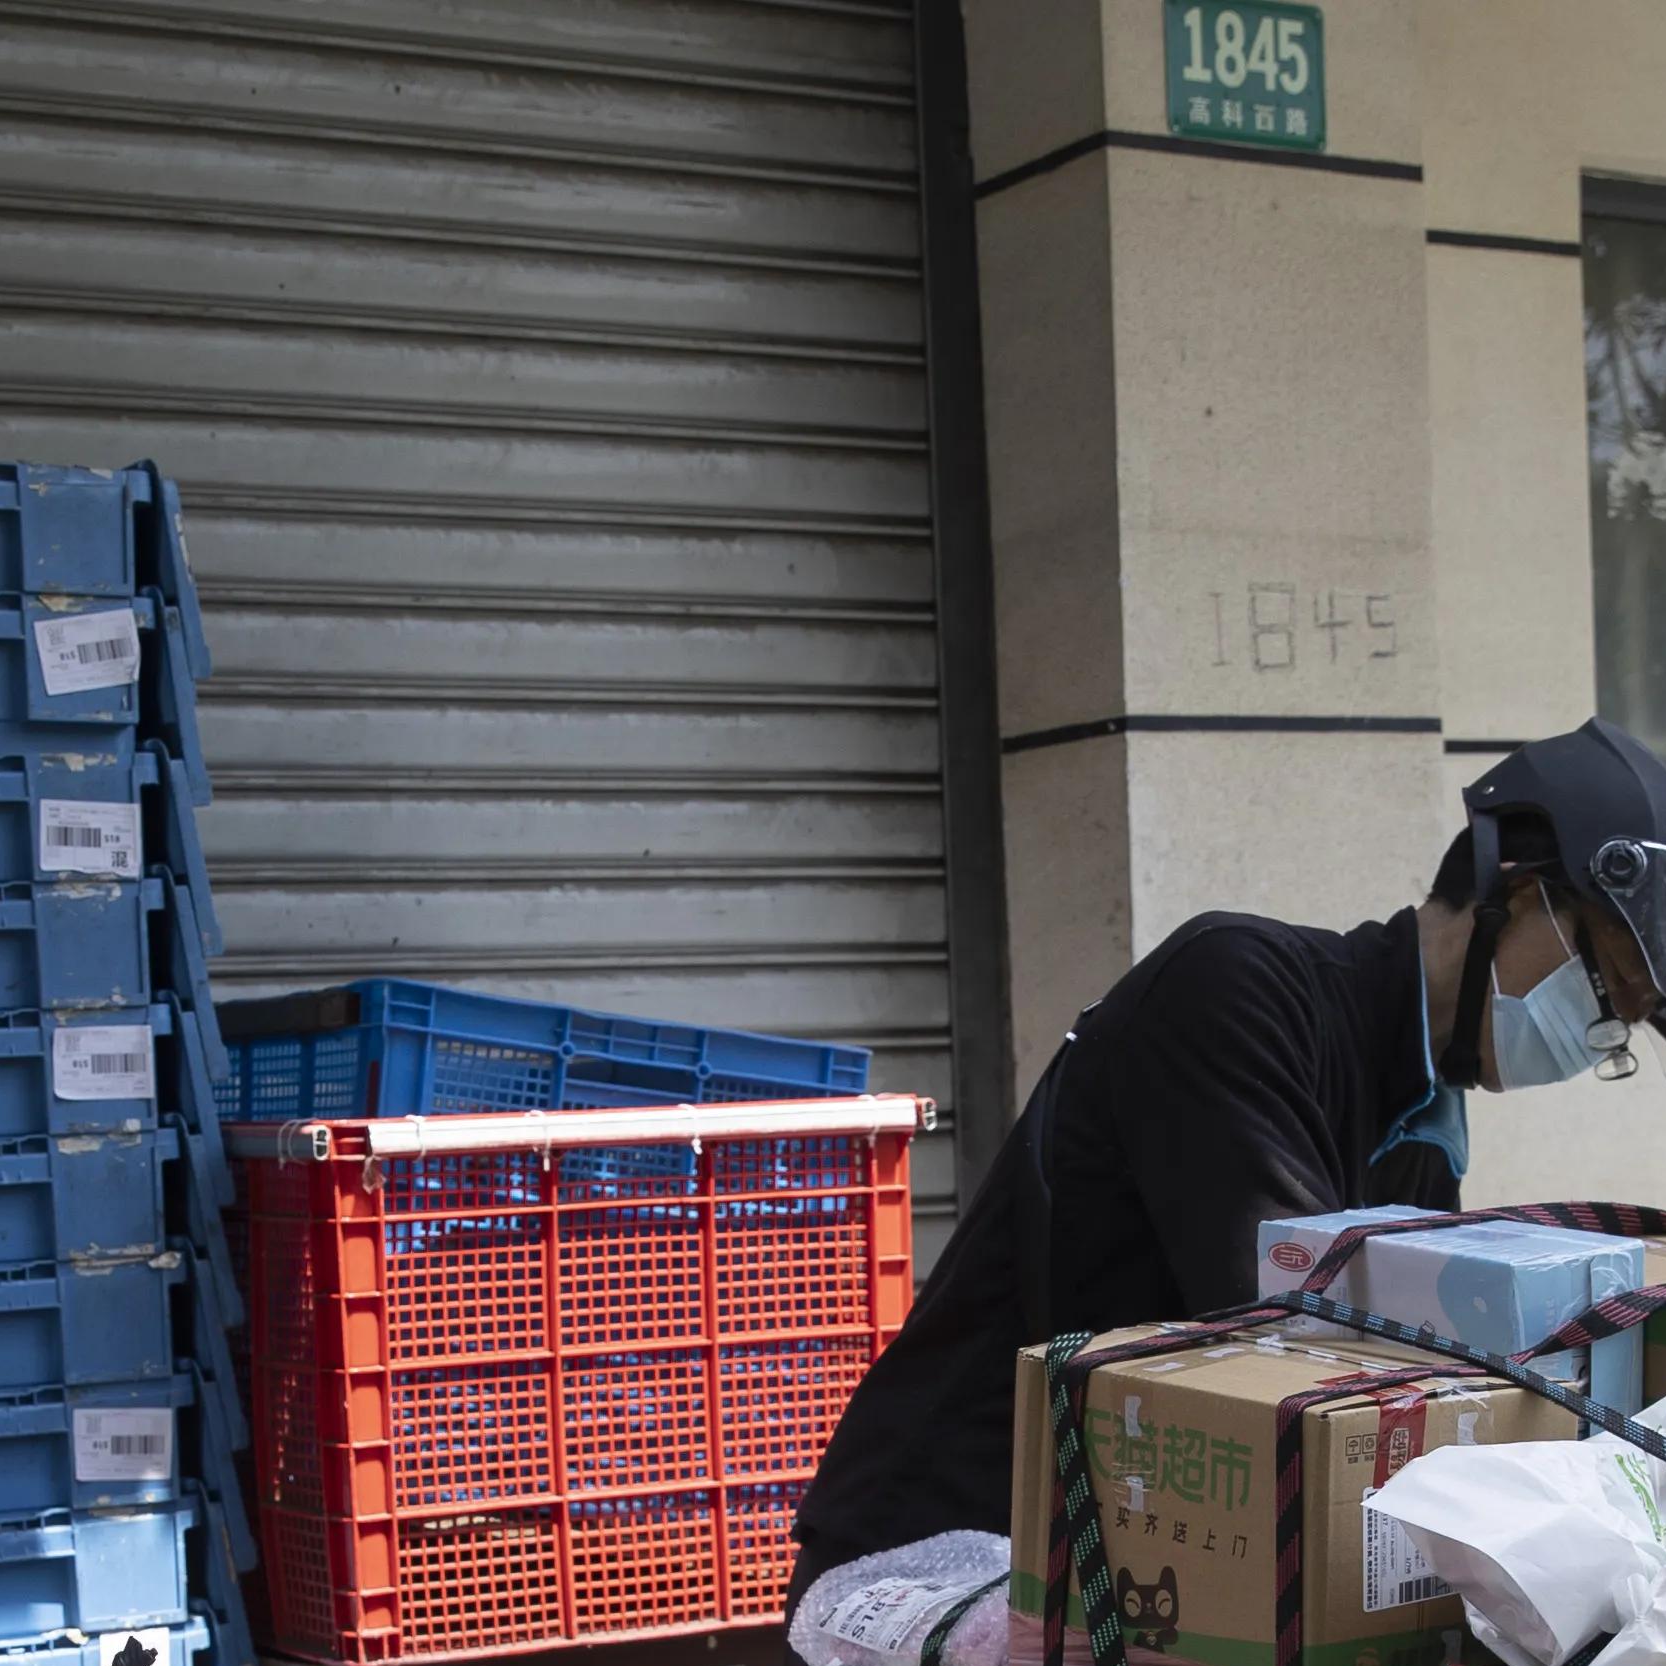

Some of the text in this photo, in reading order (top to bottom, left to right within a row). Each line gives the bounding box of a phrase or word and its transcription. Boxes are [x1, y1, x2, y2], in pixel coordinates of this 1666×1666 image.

[1182, 6, 1310, 95] 1845
[1188, 96, 1308, 136] 高科西路
[1207, 581, 1400, 673] 1845
